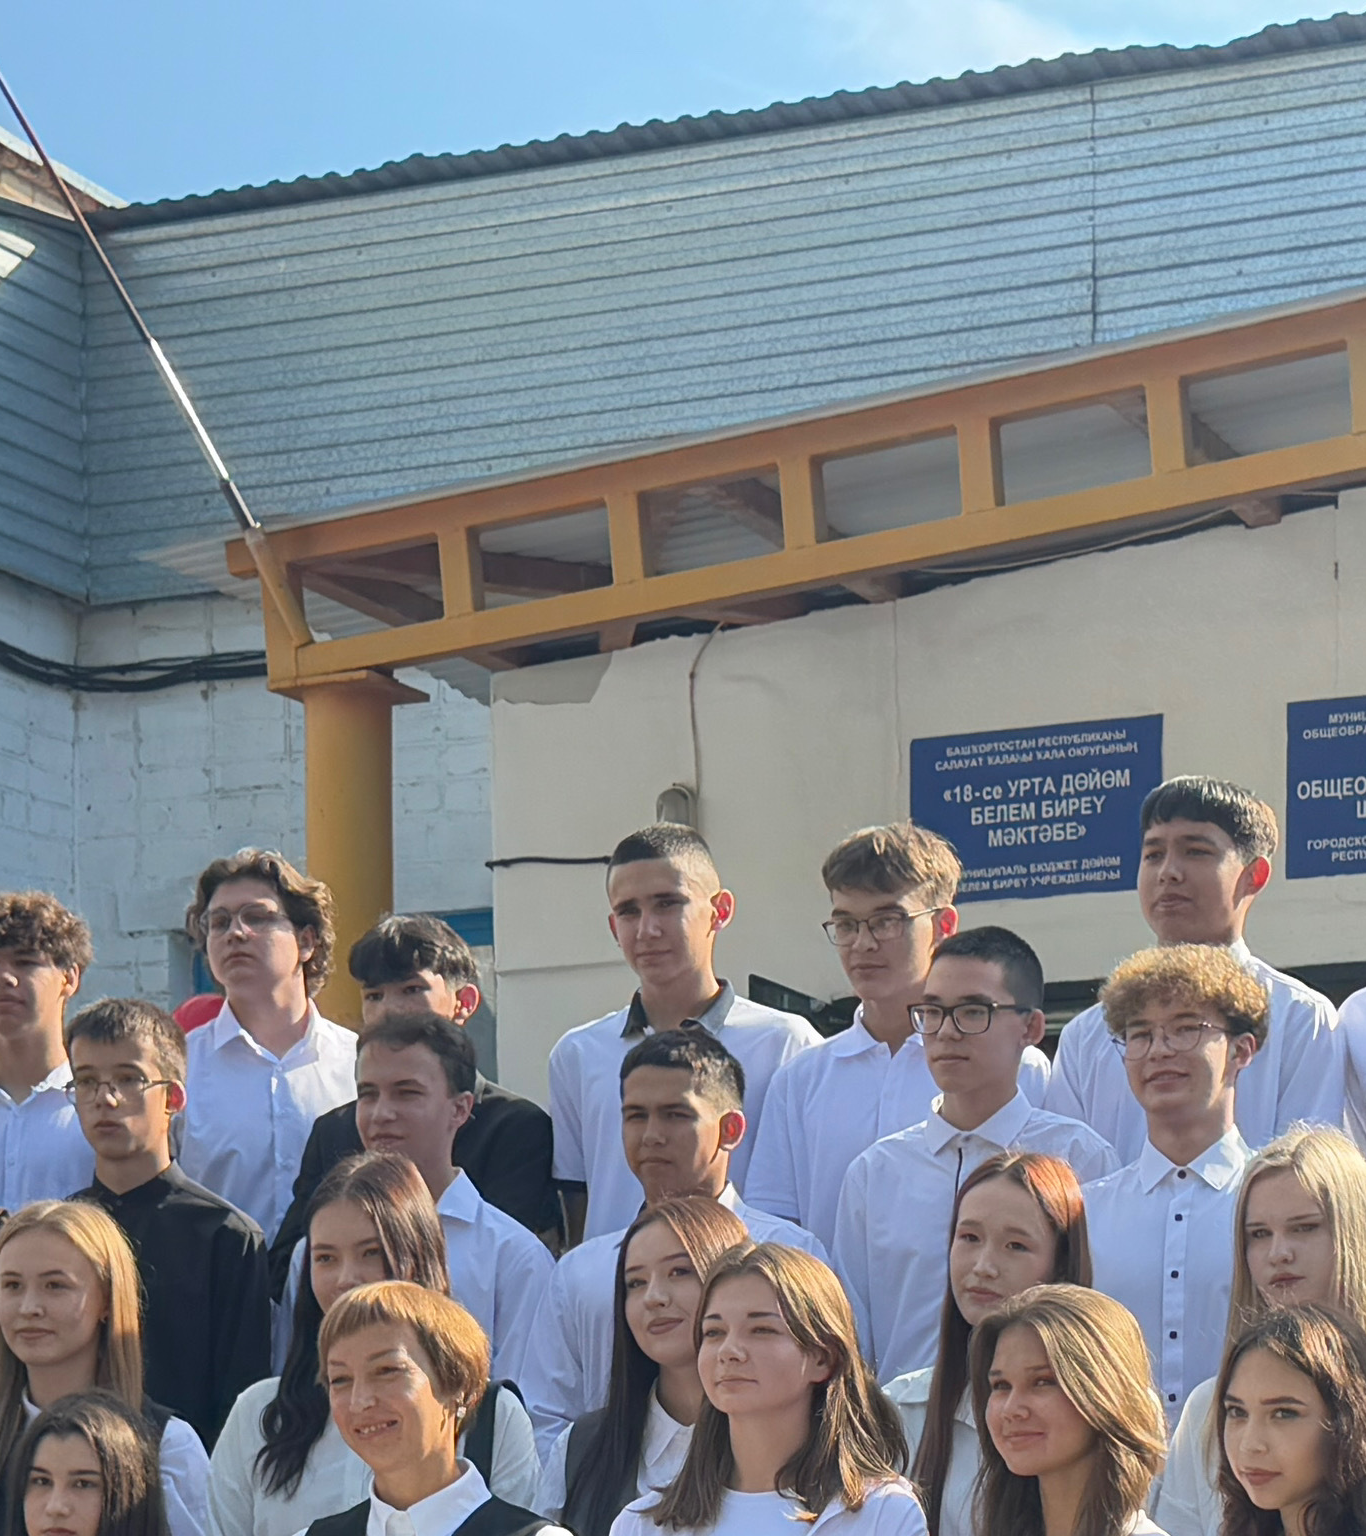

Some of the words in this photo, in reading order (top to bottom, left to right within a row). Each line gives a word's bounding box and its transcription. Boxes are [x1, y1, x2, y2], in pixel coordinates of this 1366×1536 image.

[935, 757, 983, 772] САЛАУАТ
[1007, 776, 1056, 798] УРТА
[971, 803, 1036, 826] БЕЛЕМ
